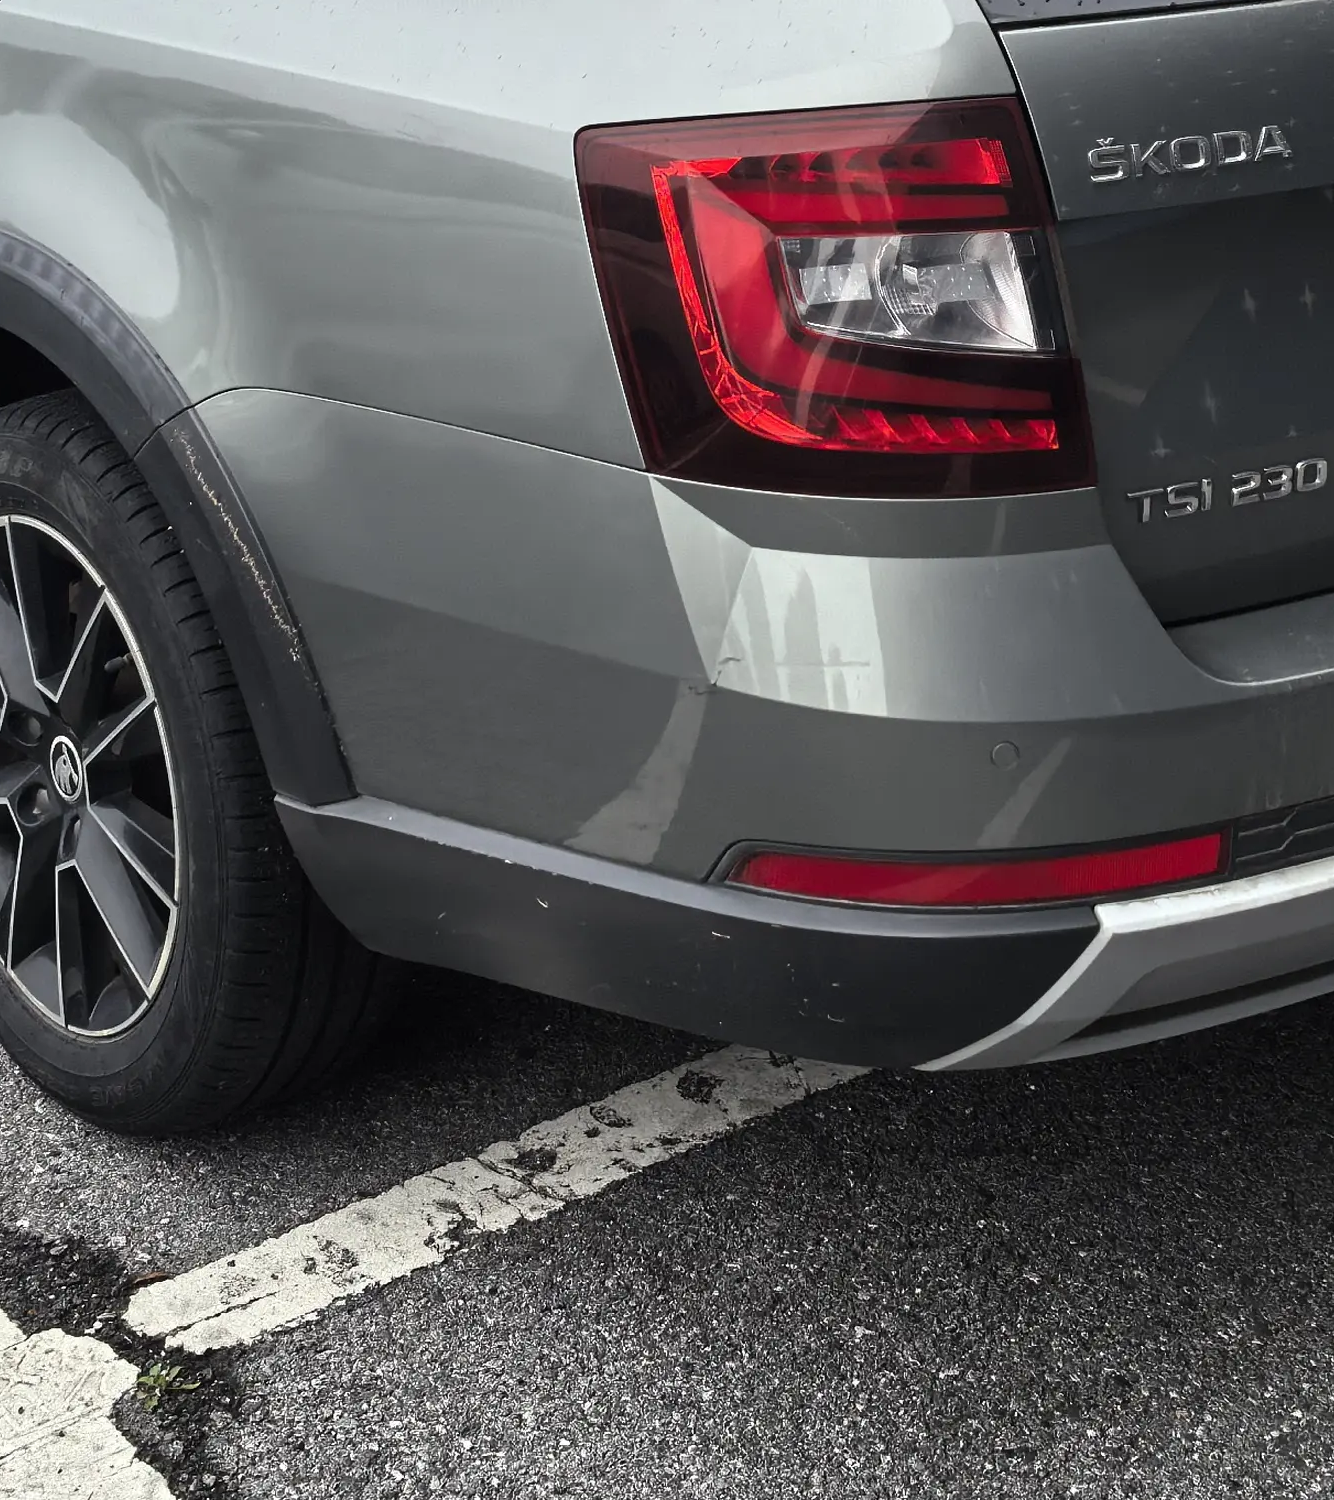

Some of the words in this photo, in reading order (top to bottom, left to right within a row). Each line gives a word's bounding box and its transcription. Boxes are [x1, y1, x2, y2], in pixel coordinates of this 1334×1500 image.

[1087, 124, 1293, 184] ŠKODA
[1126, 478, 1213, 523] TSI
[1230, 457, 1329, 508] 230
